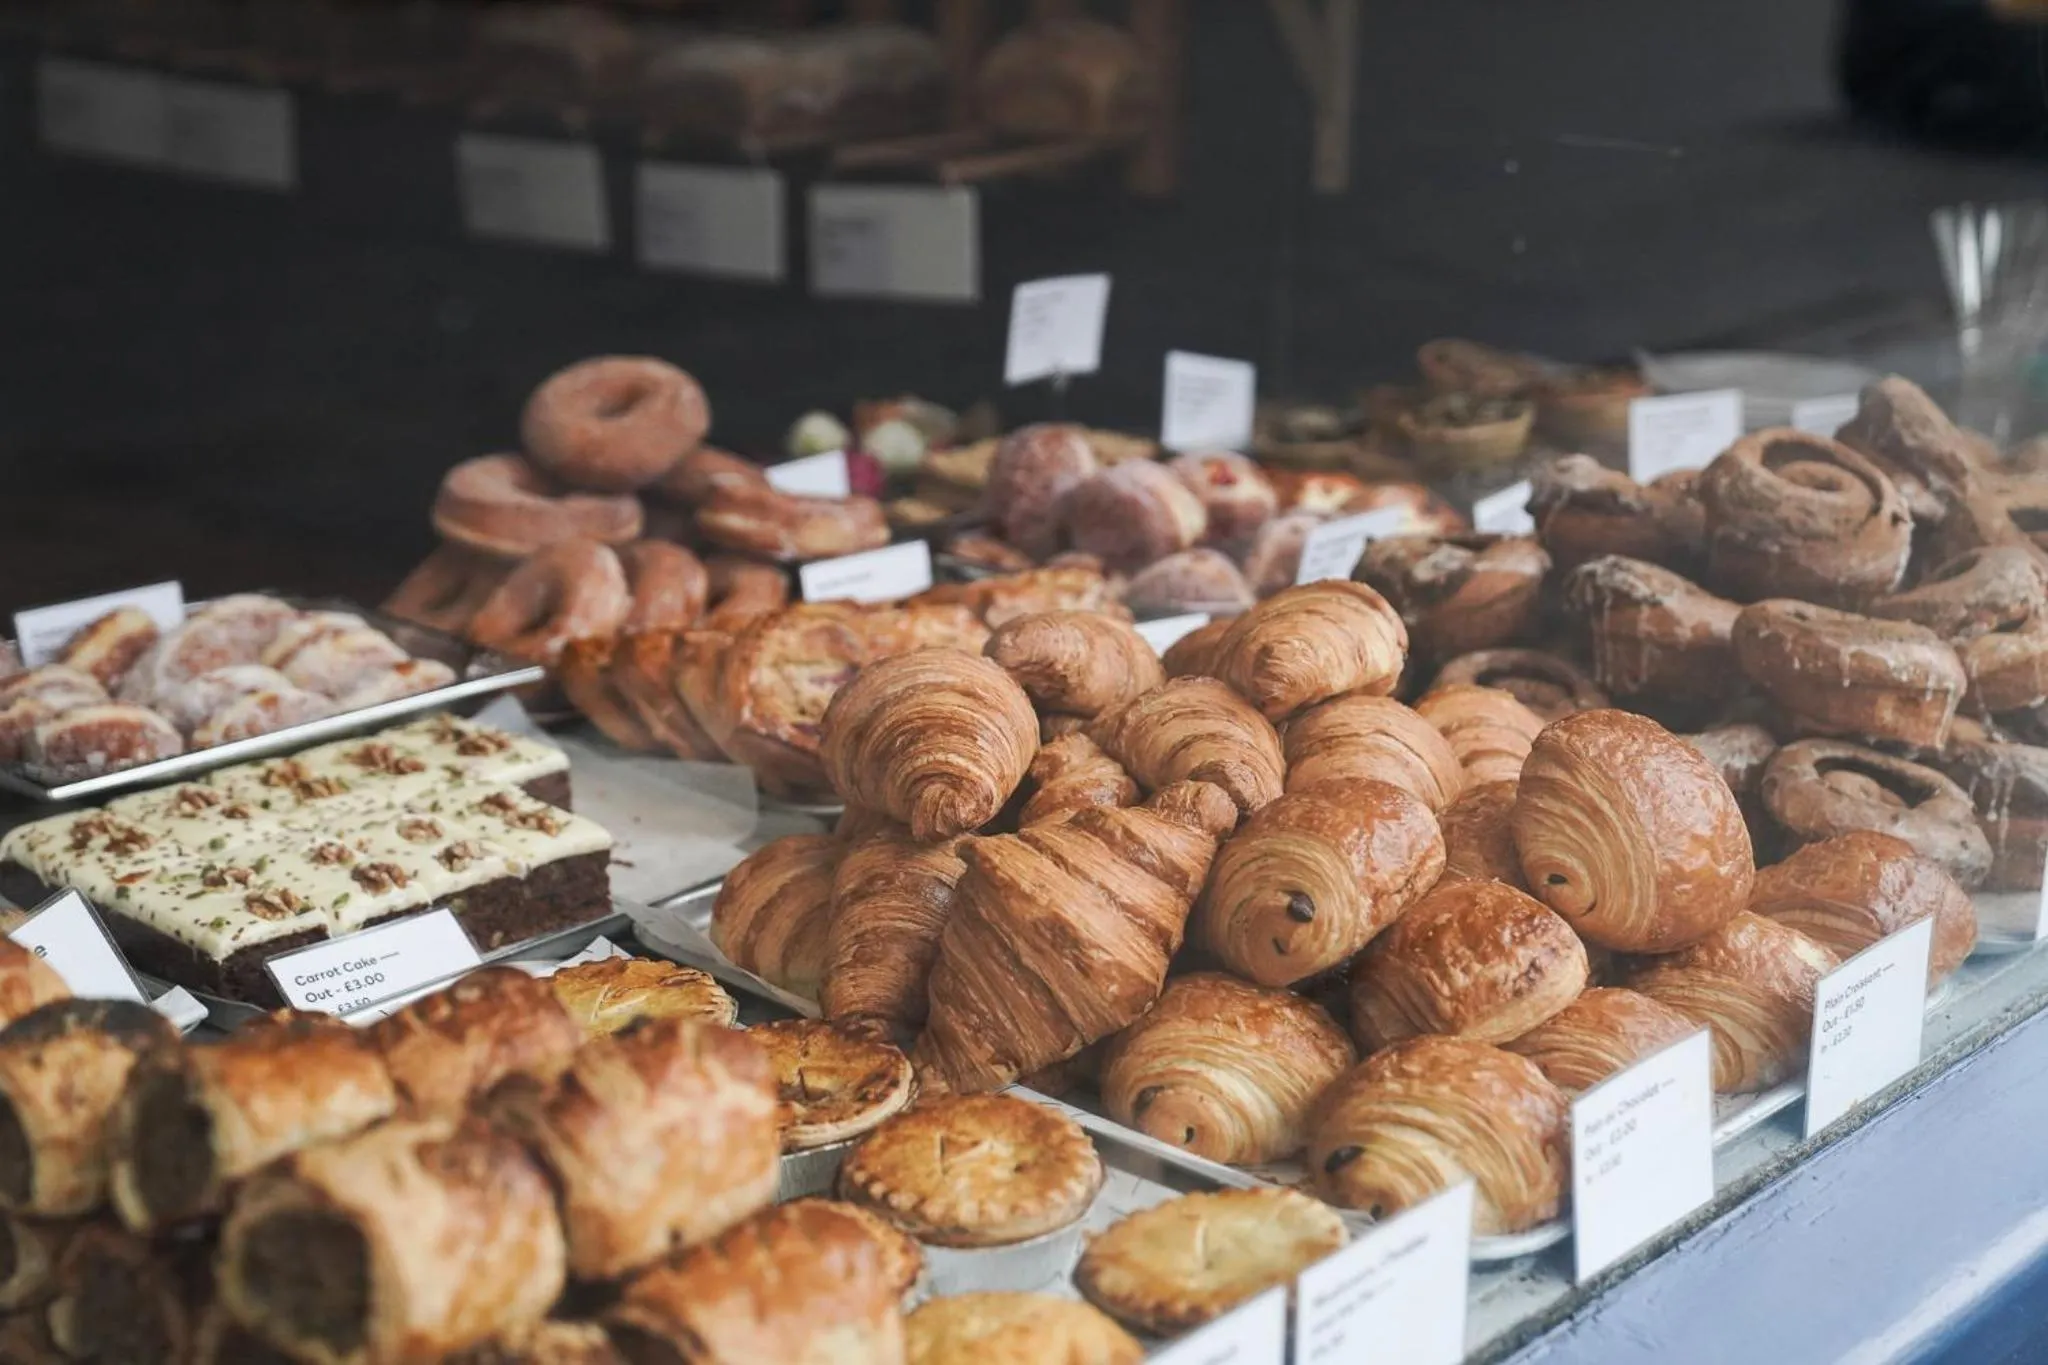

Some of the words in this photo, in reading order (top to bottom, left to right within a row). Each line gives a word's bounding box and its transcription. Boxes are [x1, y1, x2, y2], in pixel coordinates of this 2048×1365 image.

[294, 967, 341, 986] Carrot
[342, 956, 378, 973] Cake
[305, 989, 333, 1002] Out
[344, 973, 384, 992] £3.00
